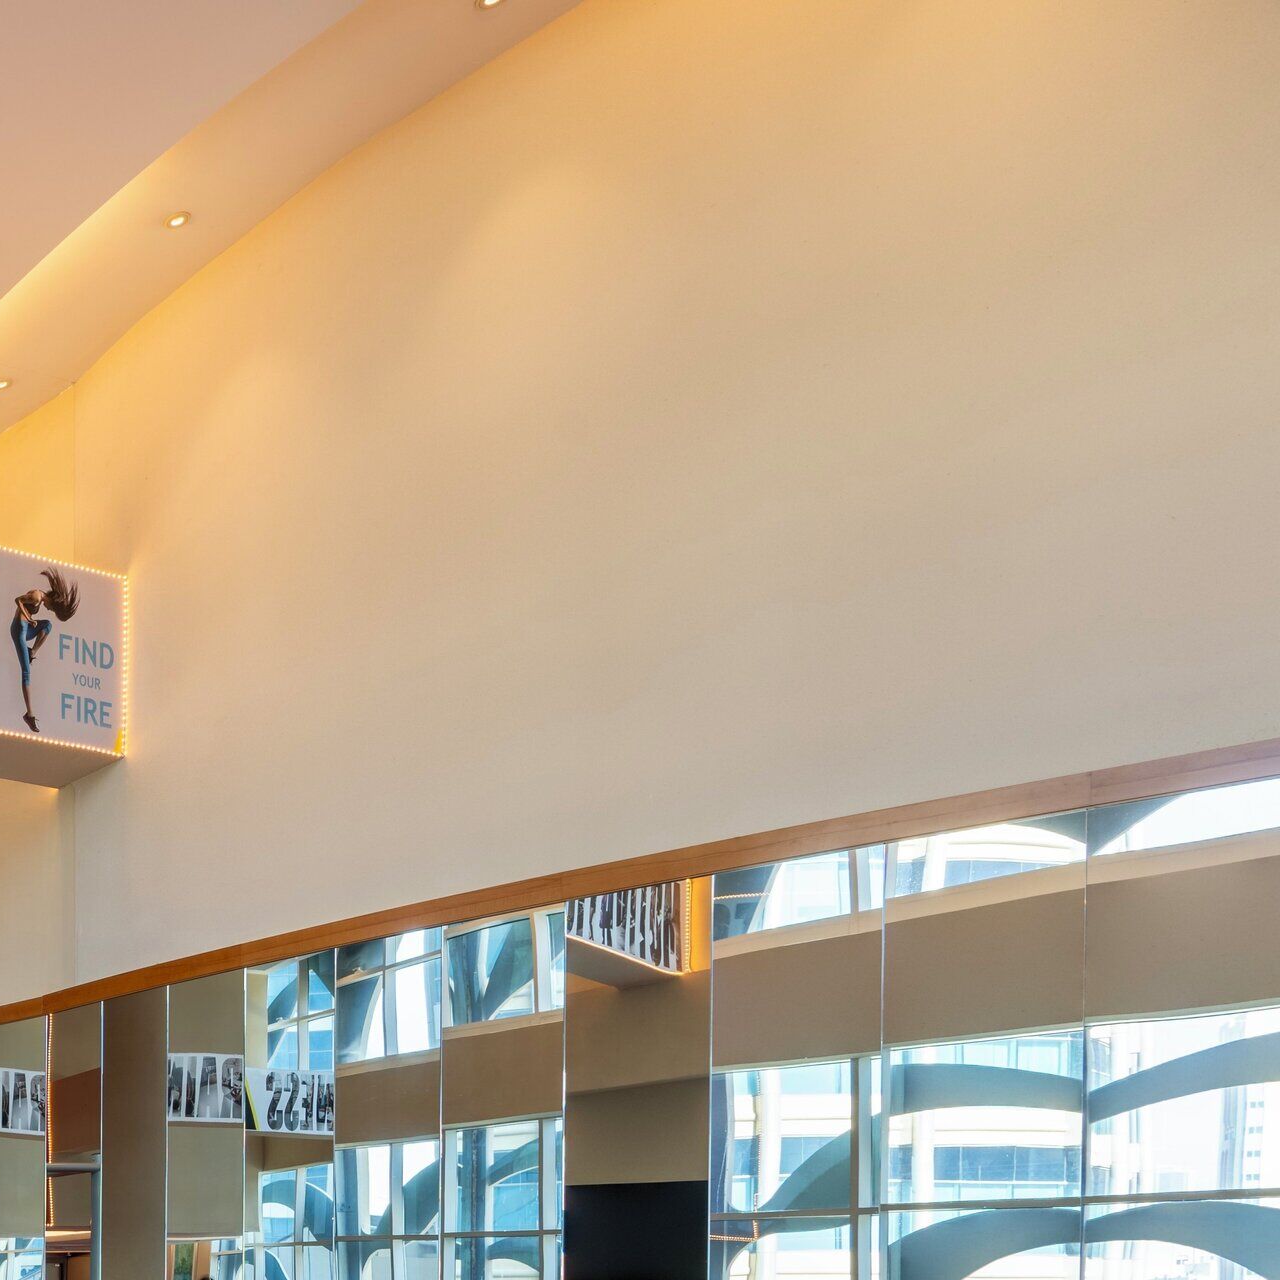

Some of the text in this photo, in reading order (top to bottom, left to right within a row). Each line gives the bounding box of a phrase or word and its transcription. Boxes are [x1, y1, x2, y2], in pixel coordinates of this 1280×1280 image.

[58, 633, 114, 670] FIND
[72, 672, 101, 690] YOUR
[60, 693, 112, 729] FIRE
